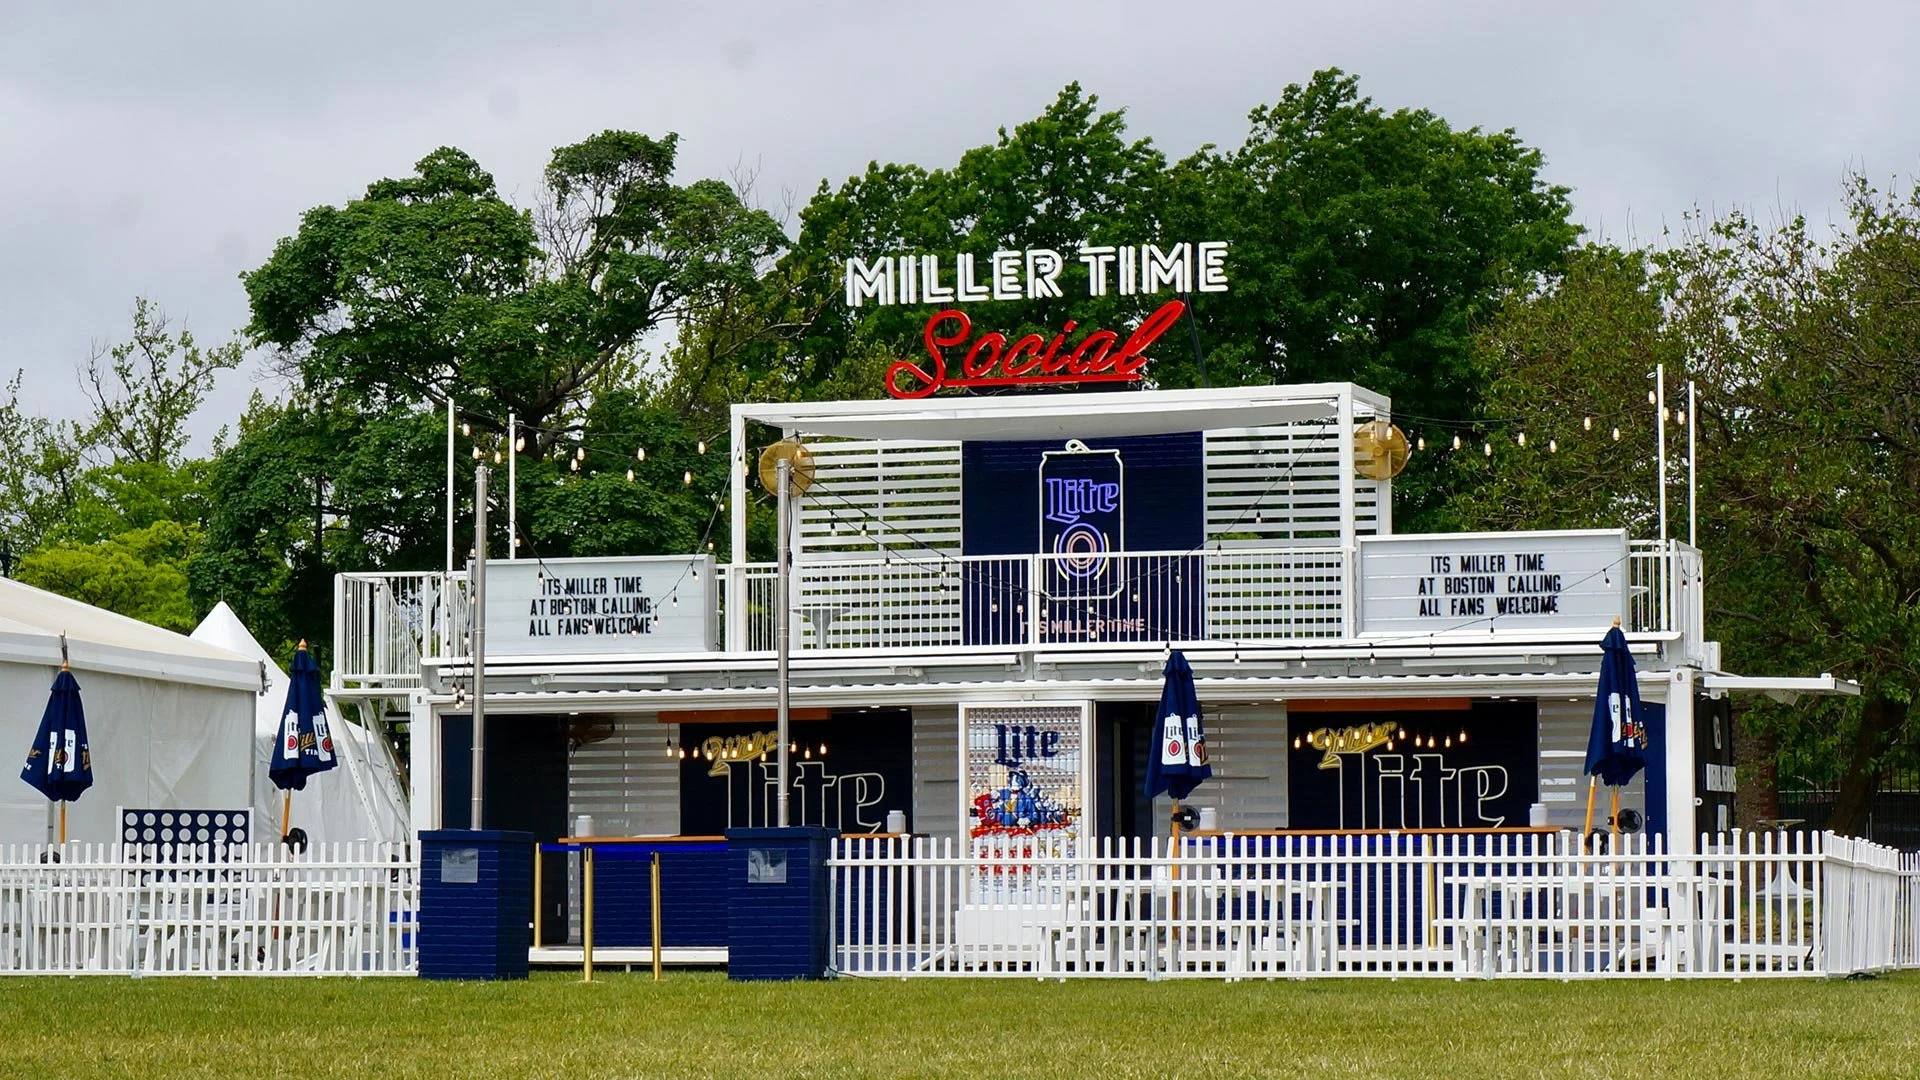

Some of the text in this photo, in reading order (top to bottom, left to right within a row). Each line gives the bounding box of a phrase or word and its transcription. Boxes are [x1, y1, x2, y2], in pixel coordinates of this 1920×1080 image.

[846, 241, 1229, 306] MILLER TIME
[885, 300, 1185, 399] Social
[1046, 478, 1119, 523] Lite
[1431, 554, 1545, 573] ITS MILLER TIME
[542, 576, 642, 595] ITS MILLER TIME
[1418, 574, 1561, 595] AT BOSTON CALLING
[530, 597, 651, 616] AT BOSTON CALLING
[1419, 595, 1559, 617] ALL FANS WELCOME
[529, 617, 651, 636] ALL FANS WELCOME
[1107, 618, 1145, 633] TIME
